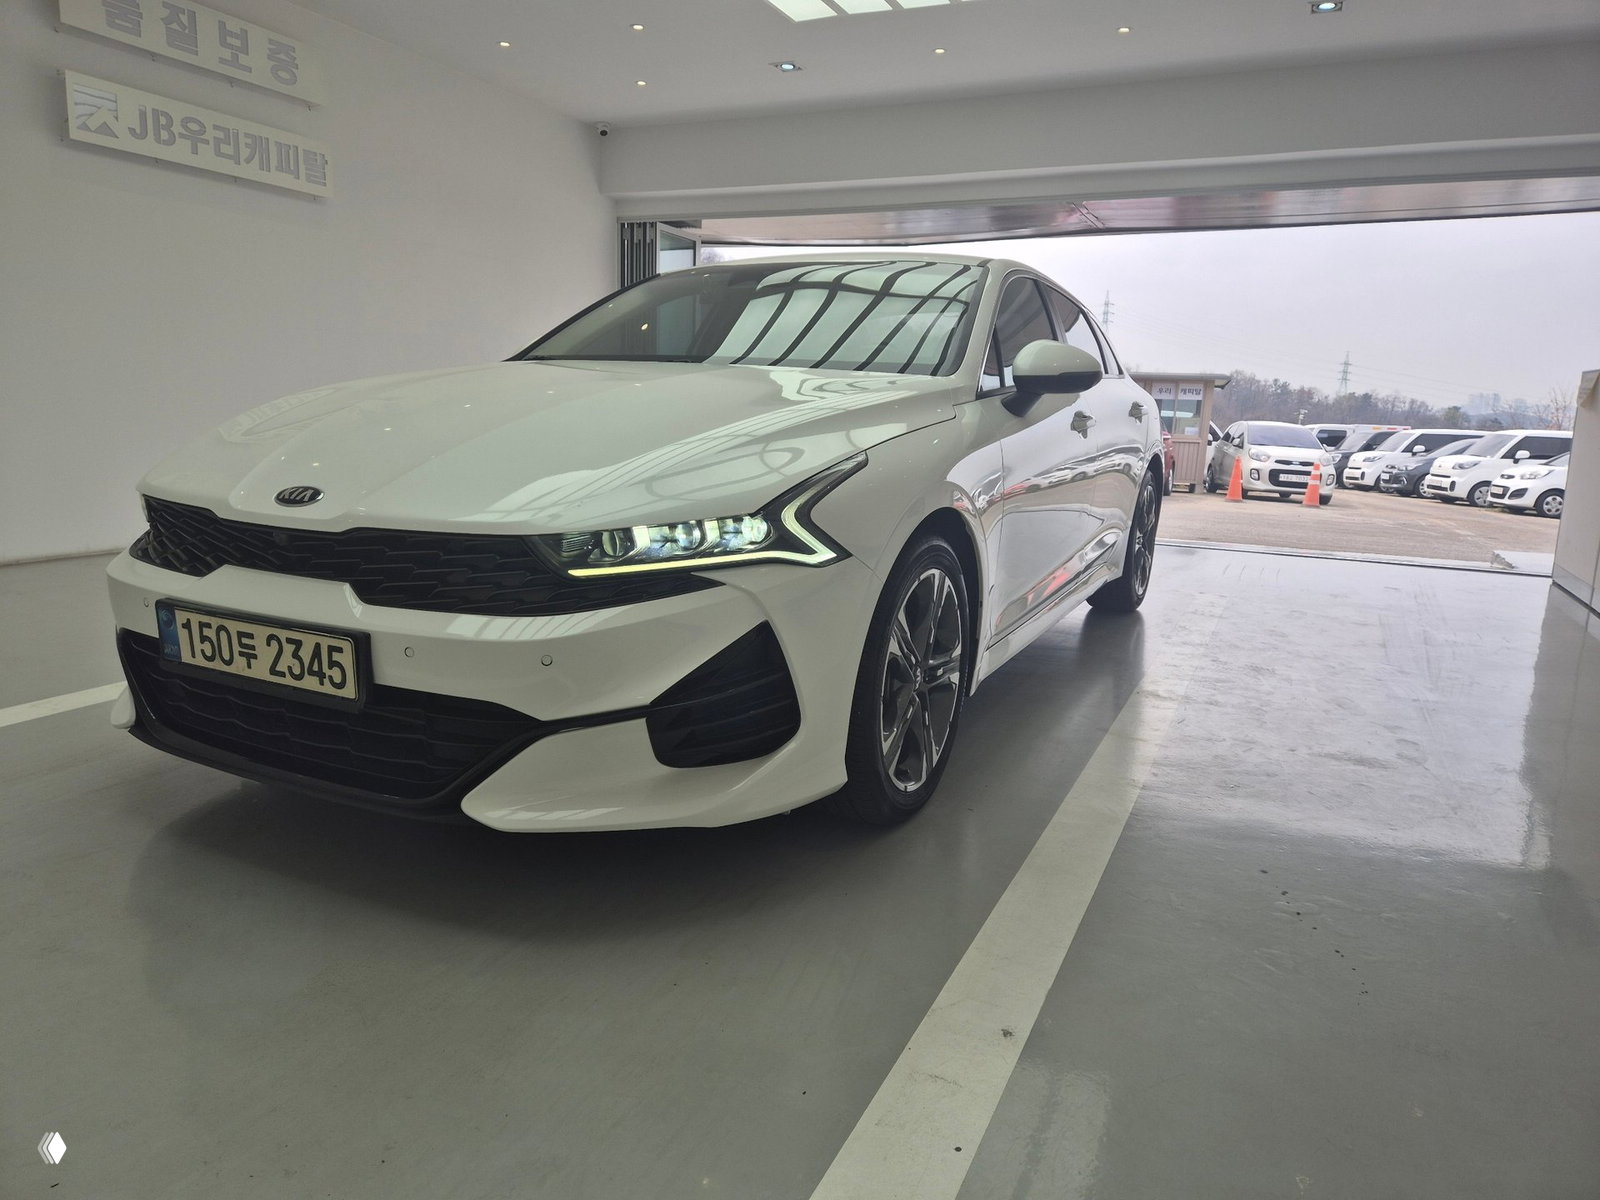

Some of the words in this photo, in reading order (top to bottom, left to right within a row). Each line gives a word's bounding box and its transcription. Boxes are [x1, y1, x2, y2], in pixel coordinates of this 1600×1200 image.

[127, 104, 329, 188] JB우리캐피탈
[1157, 386, 1172, 395] 우리
[278, 486, 315, 502] KIA
[181, 617, 258, 670] 150두
[265, 633, 347, 690] 2345
